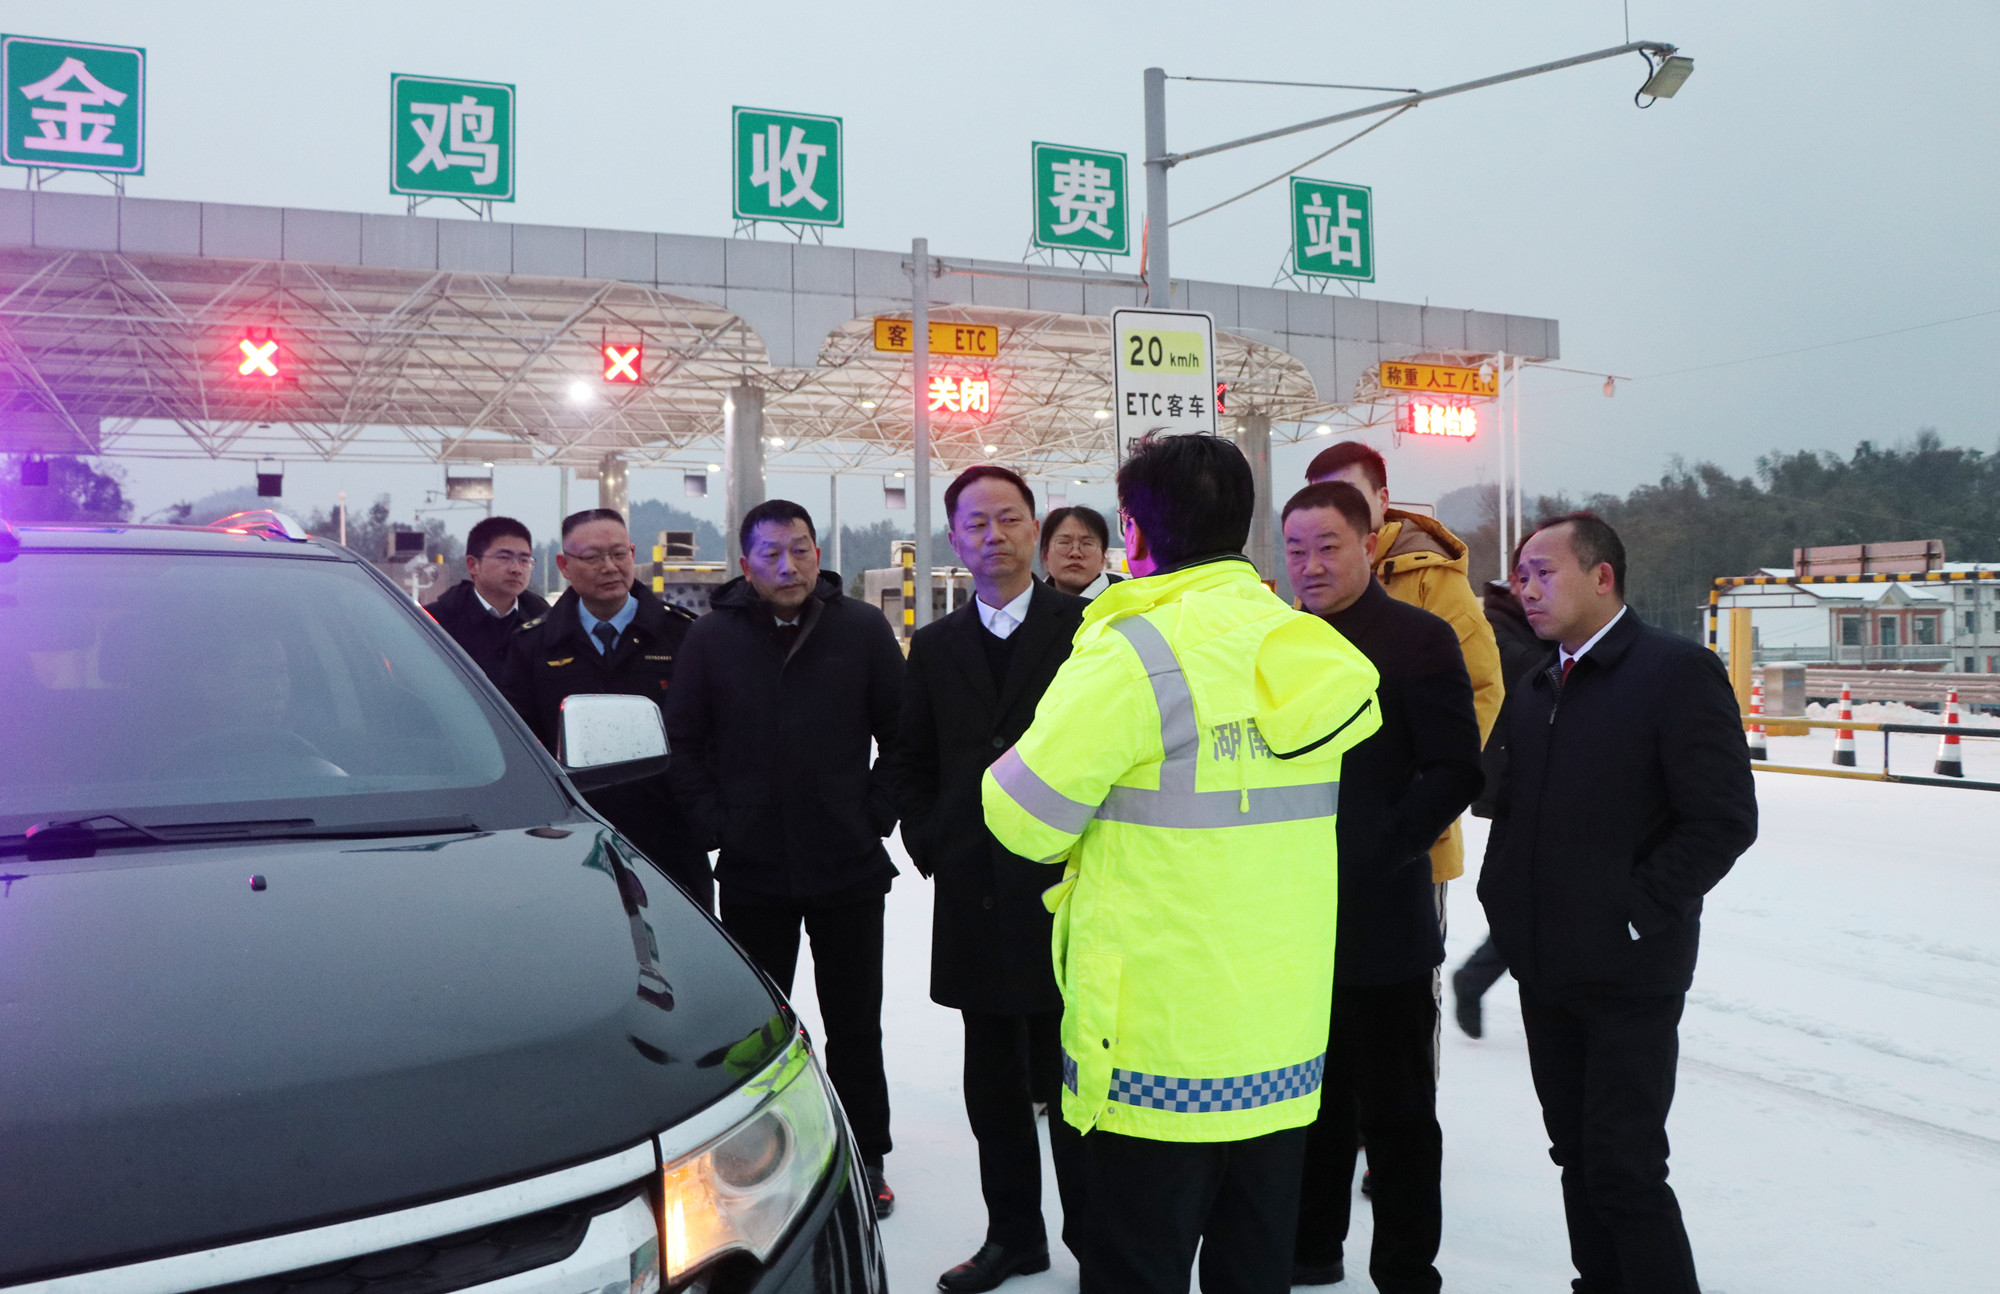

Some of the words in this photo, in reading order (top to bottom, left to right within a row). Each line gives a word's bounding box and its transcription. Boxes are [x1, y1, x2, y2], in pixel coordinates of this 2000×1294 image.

[20, 56, 128, 157] 金
[406, 95, 500, 187] 鸡
[749, 124, 829, 211] 收
[1048, 157, 1116, 241] 费
[1302, 192, 1363, 268] 站
[887, 325, 934, 348] 客
[955, 329, 987, 351] ETC
[1129, 335, 1163, 367] 20
[1170, 353, 1200, 368] km/h
[1387, 366, 1419, 387] 称重
[928, 376, 990, 413] 关闭
[1126, 392, 1206, 418] ETC客车
